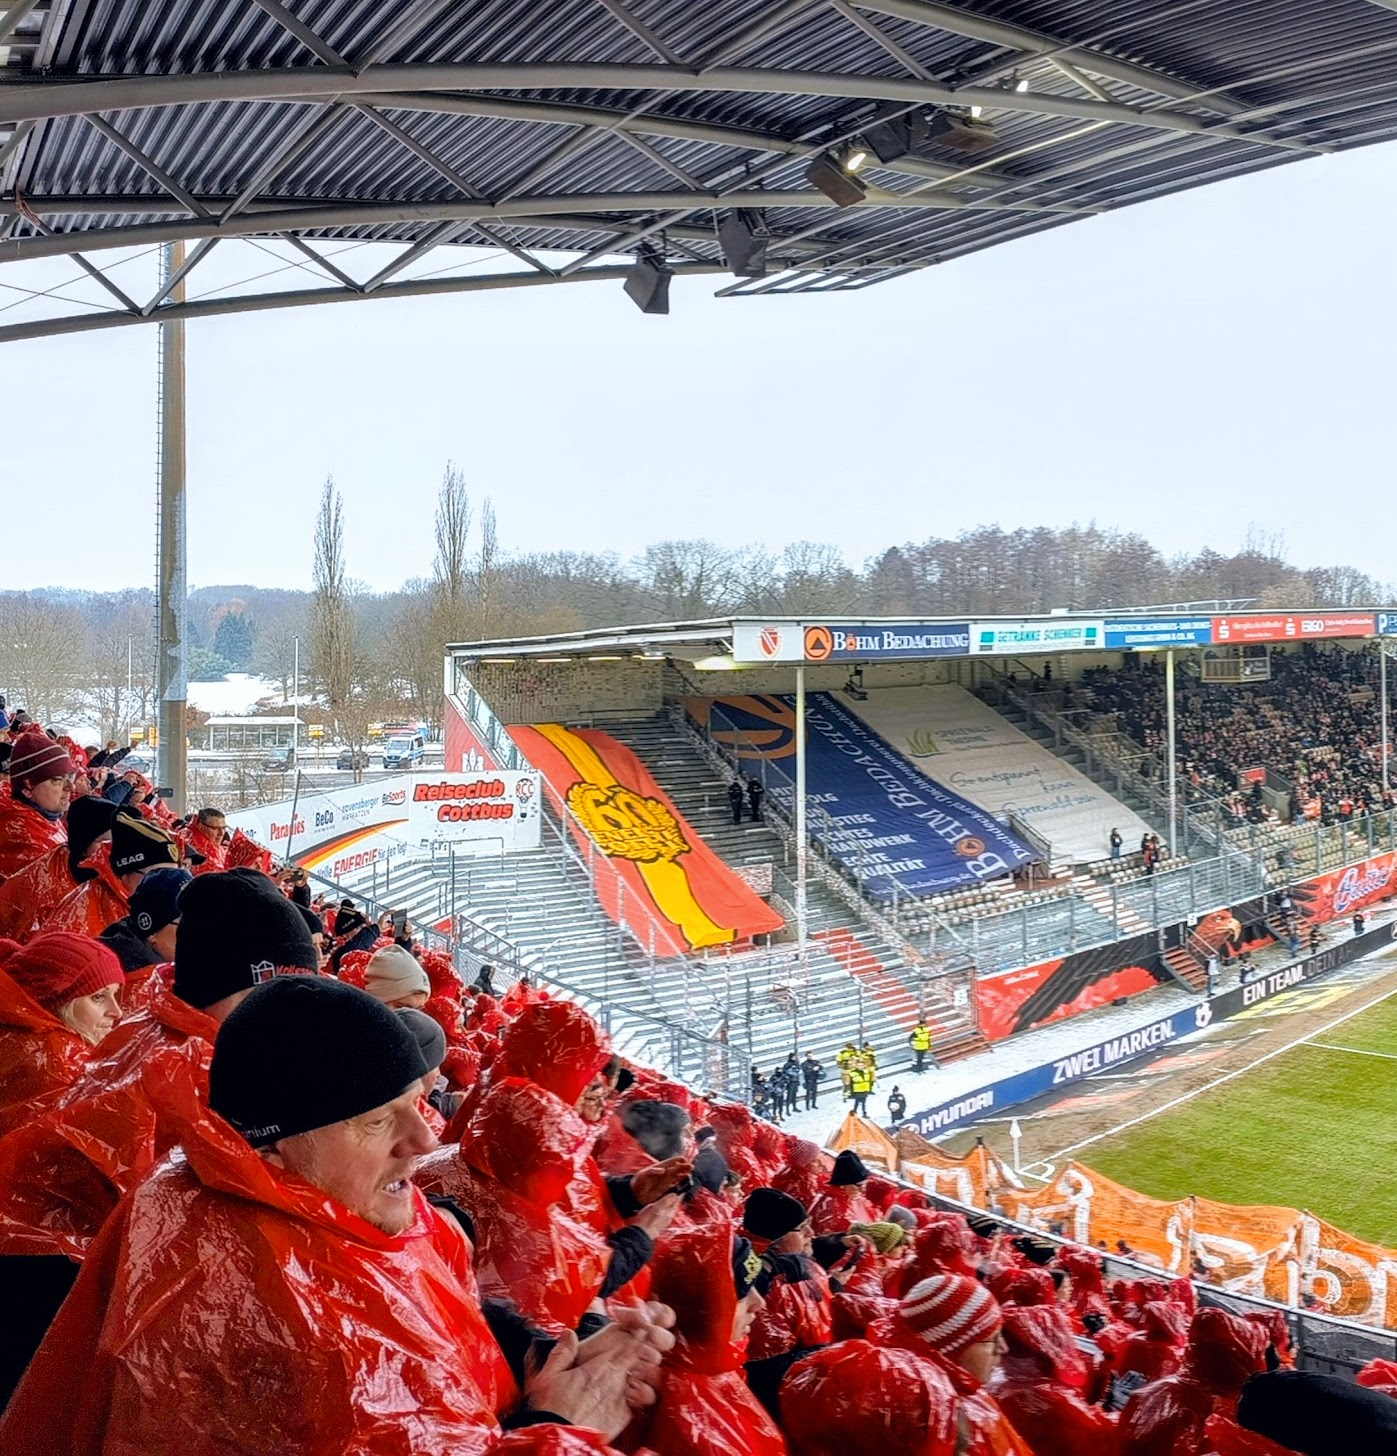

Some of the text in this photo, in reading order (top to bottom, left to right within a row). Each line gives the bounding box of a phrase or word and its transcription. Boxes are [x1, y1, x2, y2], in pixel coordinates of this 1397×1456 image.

[882, 630, 969, 649] BEDACHUNG
[381, 789, 407, 804] BeSports
[413, 778, 505, 802] Reiseclub
[315, 810, 334, 827] BeCo
[437, 802, 514, 822] Cottbus
[580, 787, 662, 830] 60
[116, 853, 145, 867] LEAG
[1243, 979, 1267, 1006] EIN
[1268, 965, 1307, 993] TEAM.
[1052, 1018, 1176, 1084] ZWEI MARKEN.
[920, 1090, 994, 1134] HYUNDAI
